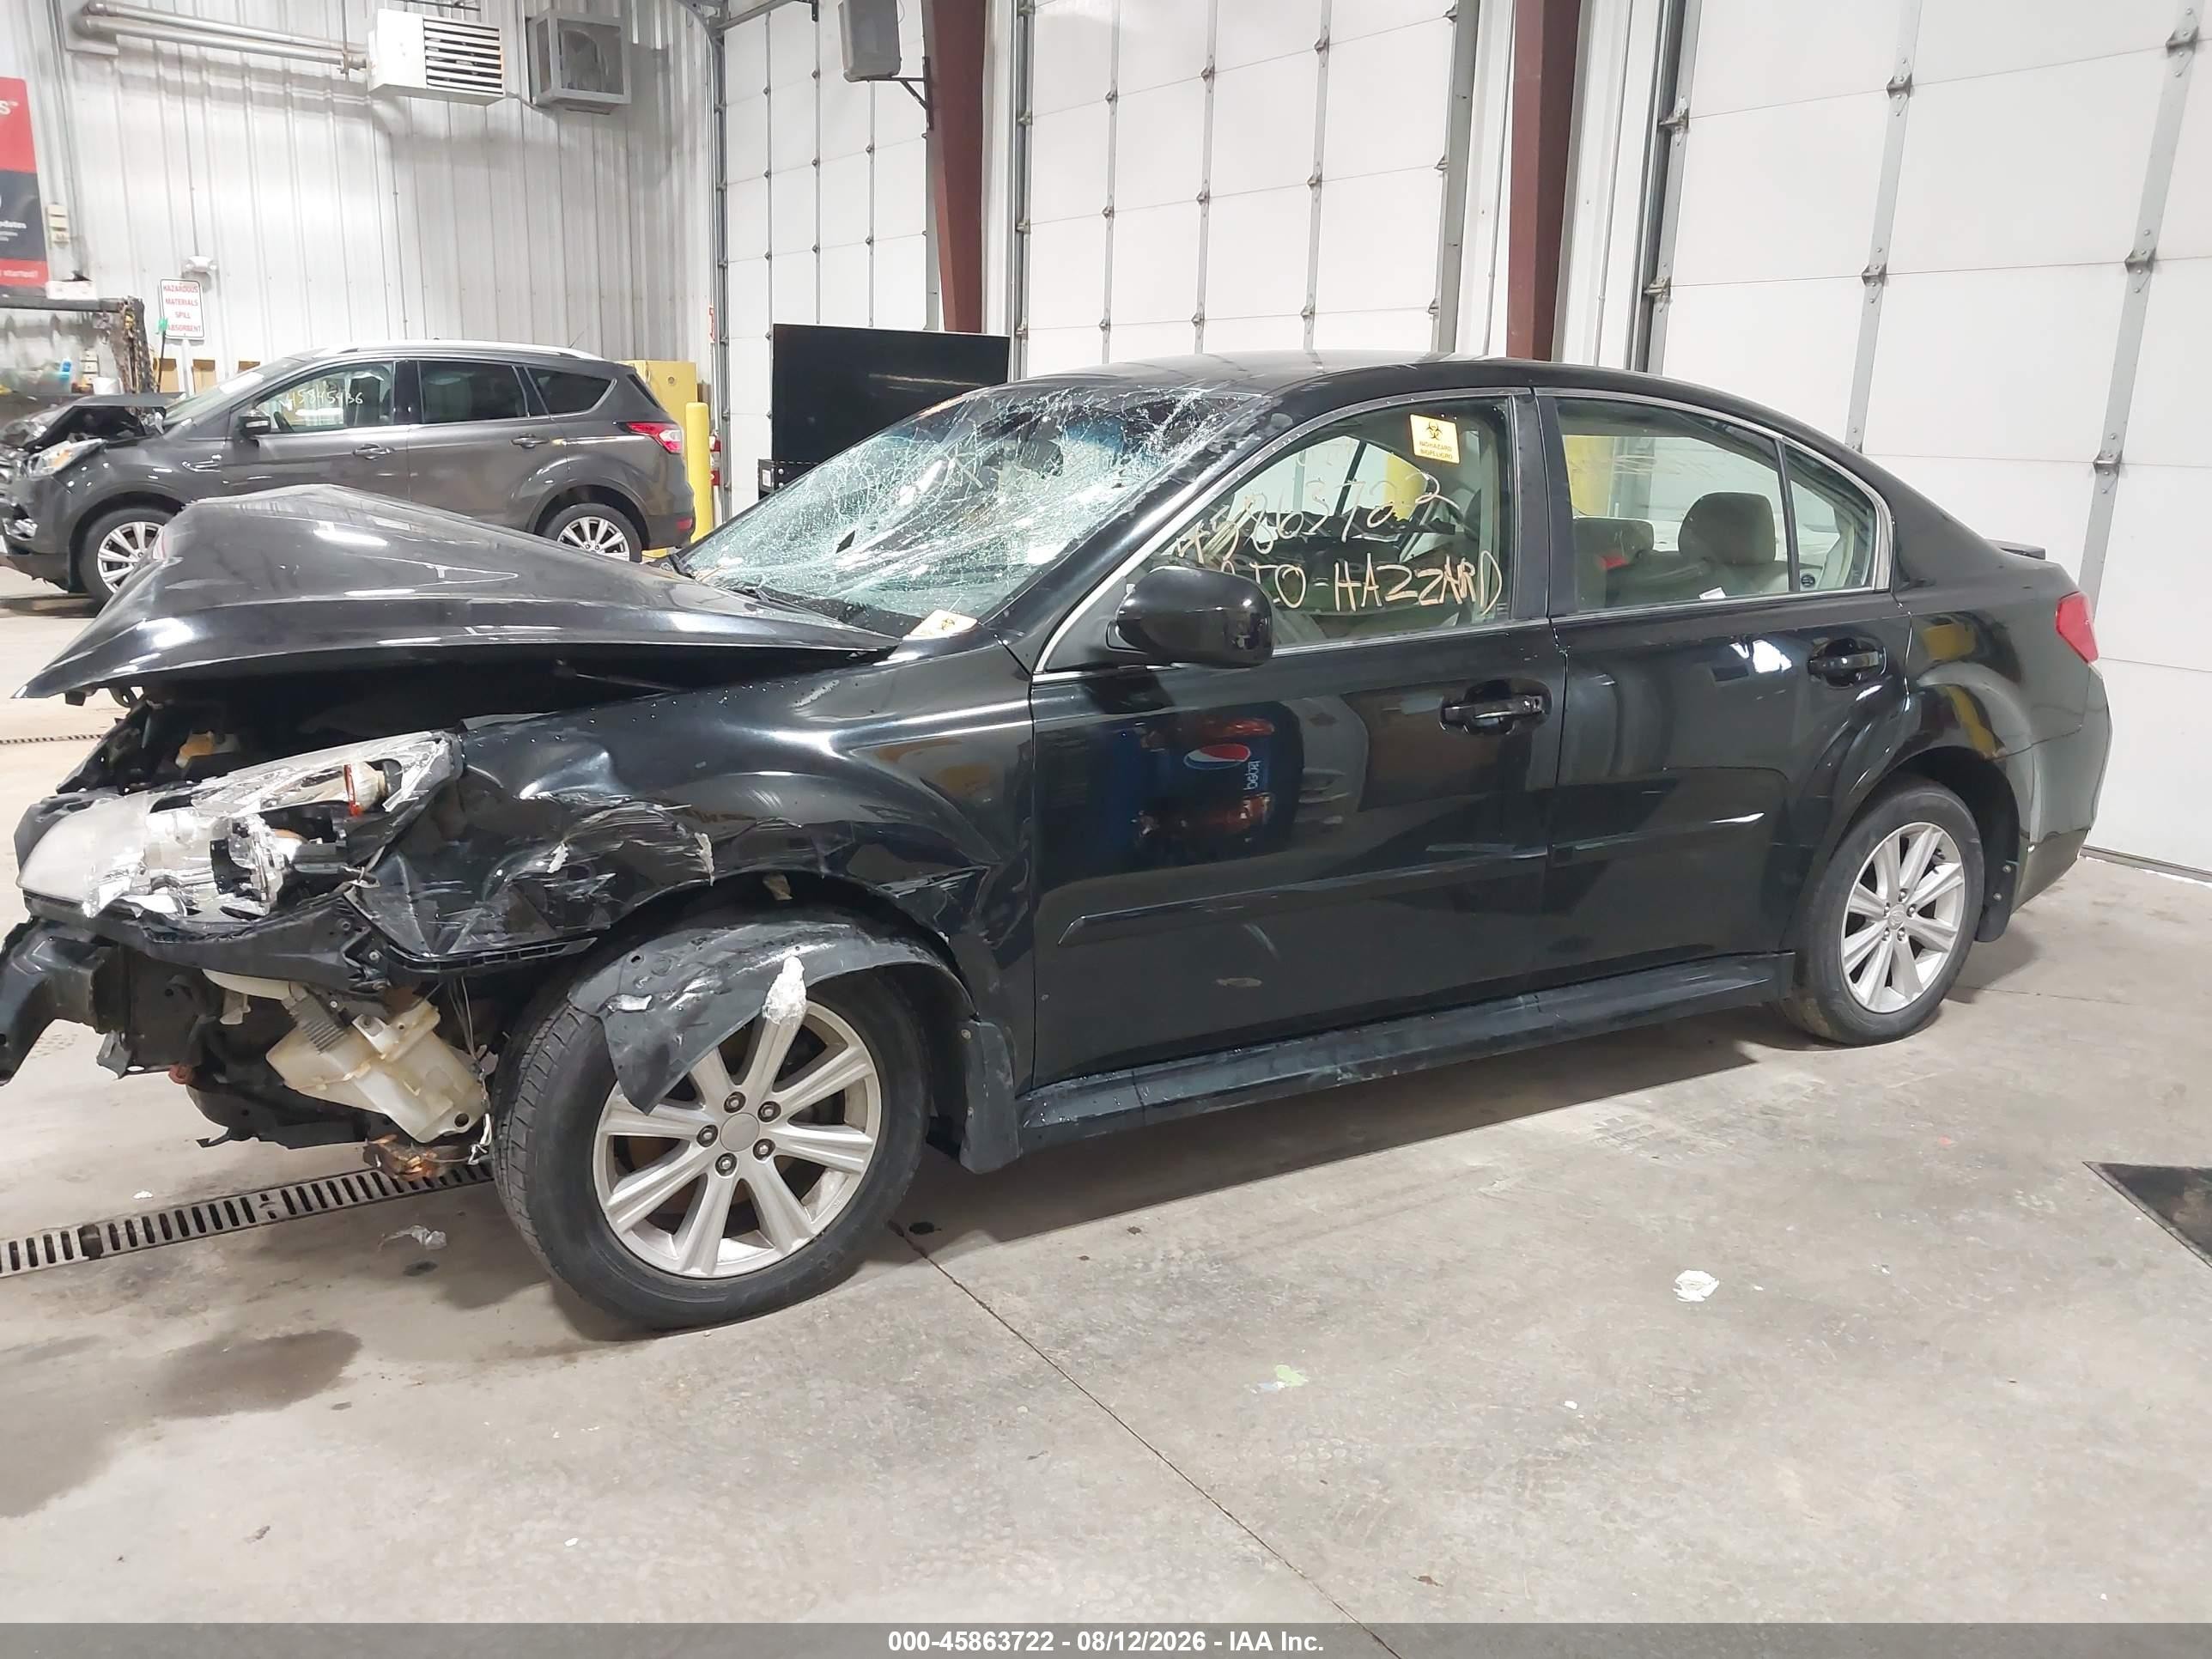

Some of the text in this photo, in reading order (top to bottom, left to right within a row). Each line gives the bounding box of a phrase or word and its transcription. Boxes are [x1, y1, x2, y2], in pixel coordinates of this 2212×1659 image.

[164, 284, 198, 294] HAZARDOUS
[165, 297, 199, 307] MATERIALS
[174, 311, 191, 319] SPILL
[167, 324, 202, 333] ABSORBENT
[1419, 441, 1453, 453] BIOHAZARD
[1419, 448, 1454, 460] BIOPELIGRO
